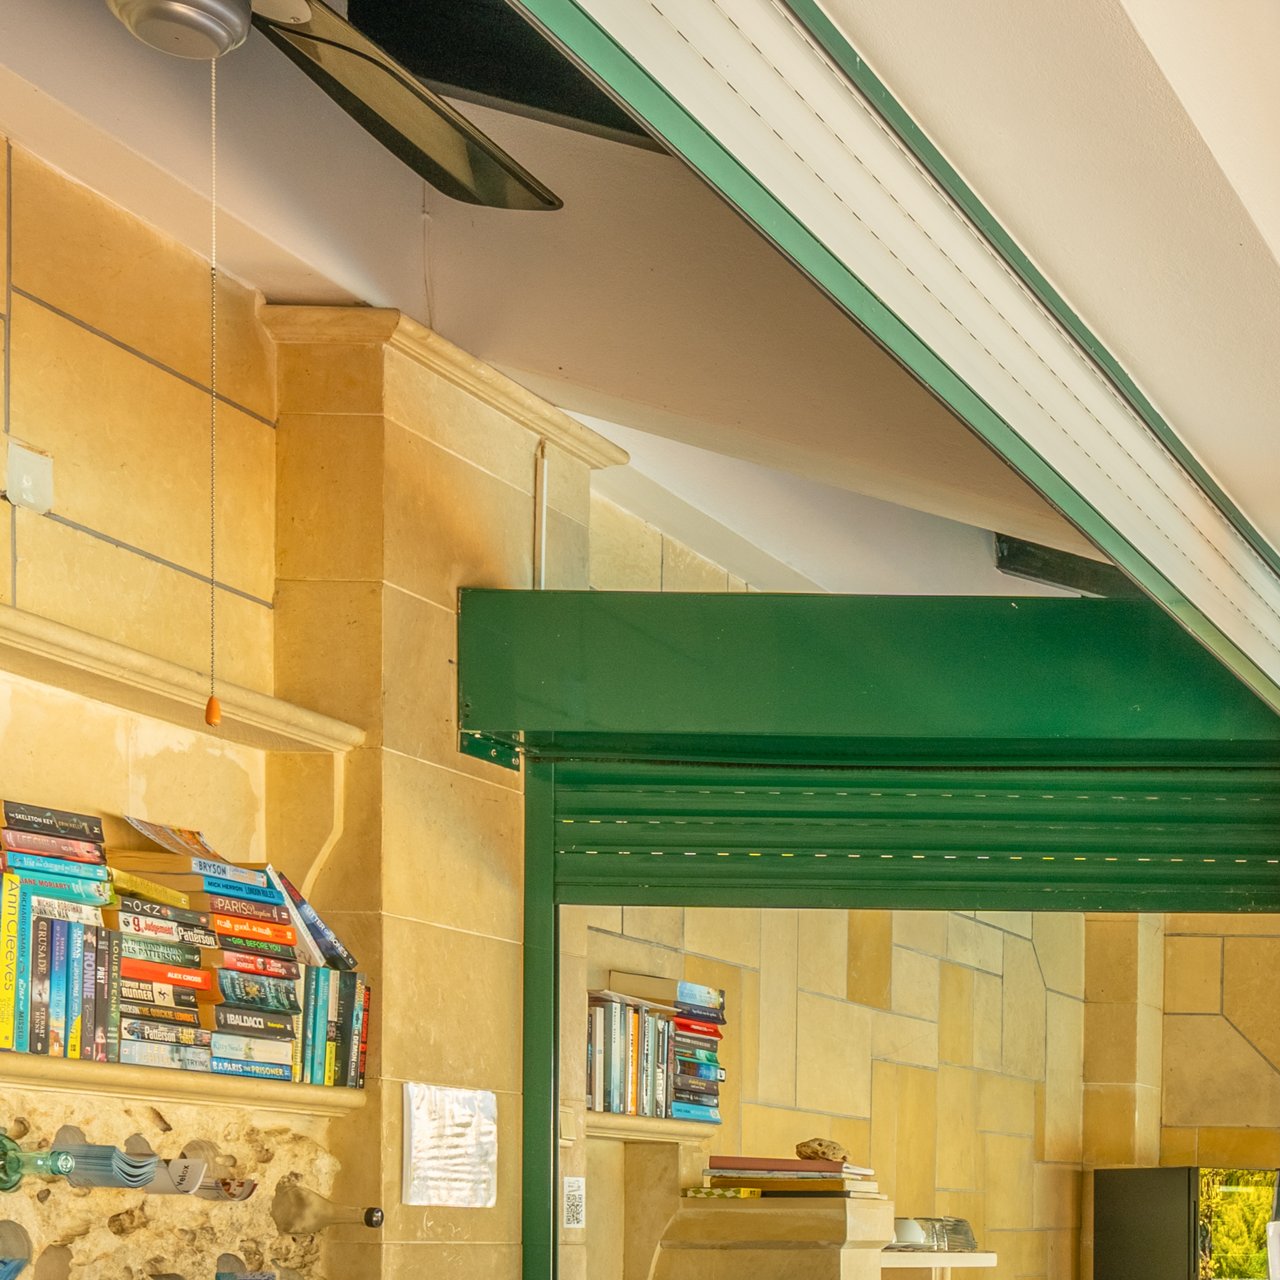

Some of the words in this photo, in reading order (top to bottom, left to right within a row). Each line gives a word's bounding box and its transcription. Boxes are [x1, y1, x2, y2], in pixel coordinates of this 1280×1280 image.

[15, 813, 42, 824] SKELETON
[198, 861, 227, 876] BRYSON
[38, 879, 71, 890] MORIARTY
[207, 881, 221, 889] MICK
[6, 879, 19, 915] Ann
[217, 898, 248, 915] PARIS
[177, 926, 216, 946] Patterson
[37, 921, 47, 974] CRUSADE
[245, 939, 269, 950] BEFORE
[268, 943, 281, 953] YOU
[328, 933, 350, 958] BONES
[4, 919, 18, 991] Cleeves
[111, 940, 119, 979] LOUISE
[138, 948, 183, 962] PATTERSON
[84, 951, 95, 999] RONNIE
[96, 966, 105, 984] PREY
[167, 972, 183, 980] ALEX
[183, 974, 202, 983] CROSS
[110, 981, 118, 1019] PENNY
[121, 987, 154, 1000] RUNNER
[231, 1014, 264, 1029] BALDACCI
[144, 1025, 176, 1042] Patterson
[351, 1035, 359, 1062] DEMON
[223, 1062, 242, 1073] PARIS
[251, 1066, 283, 1076] PRISONER
